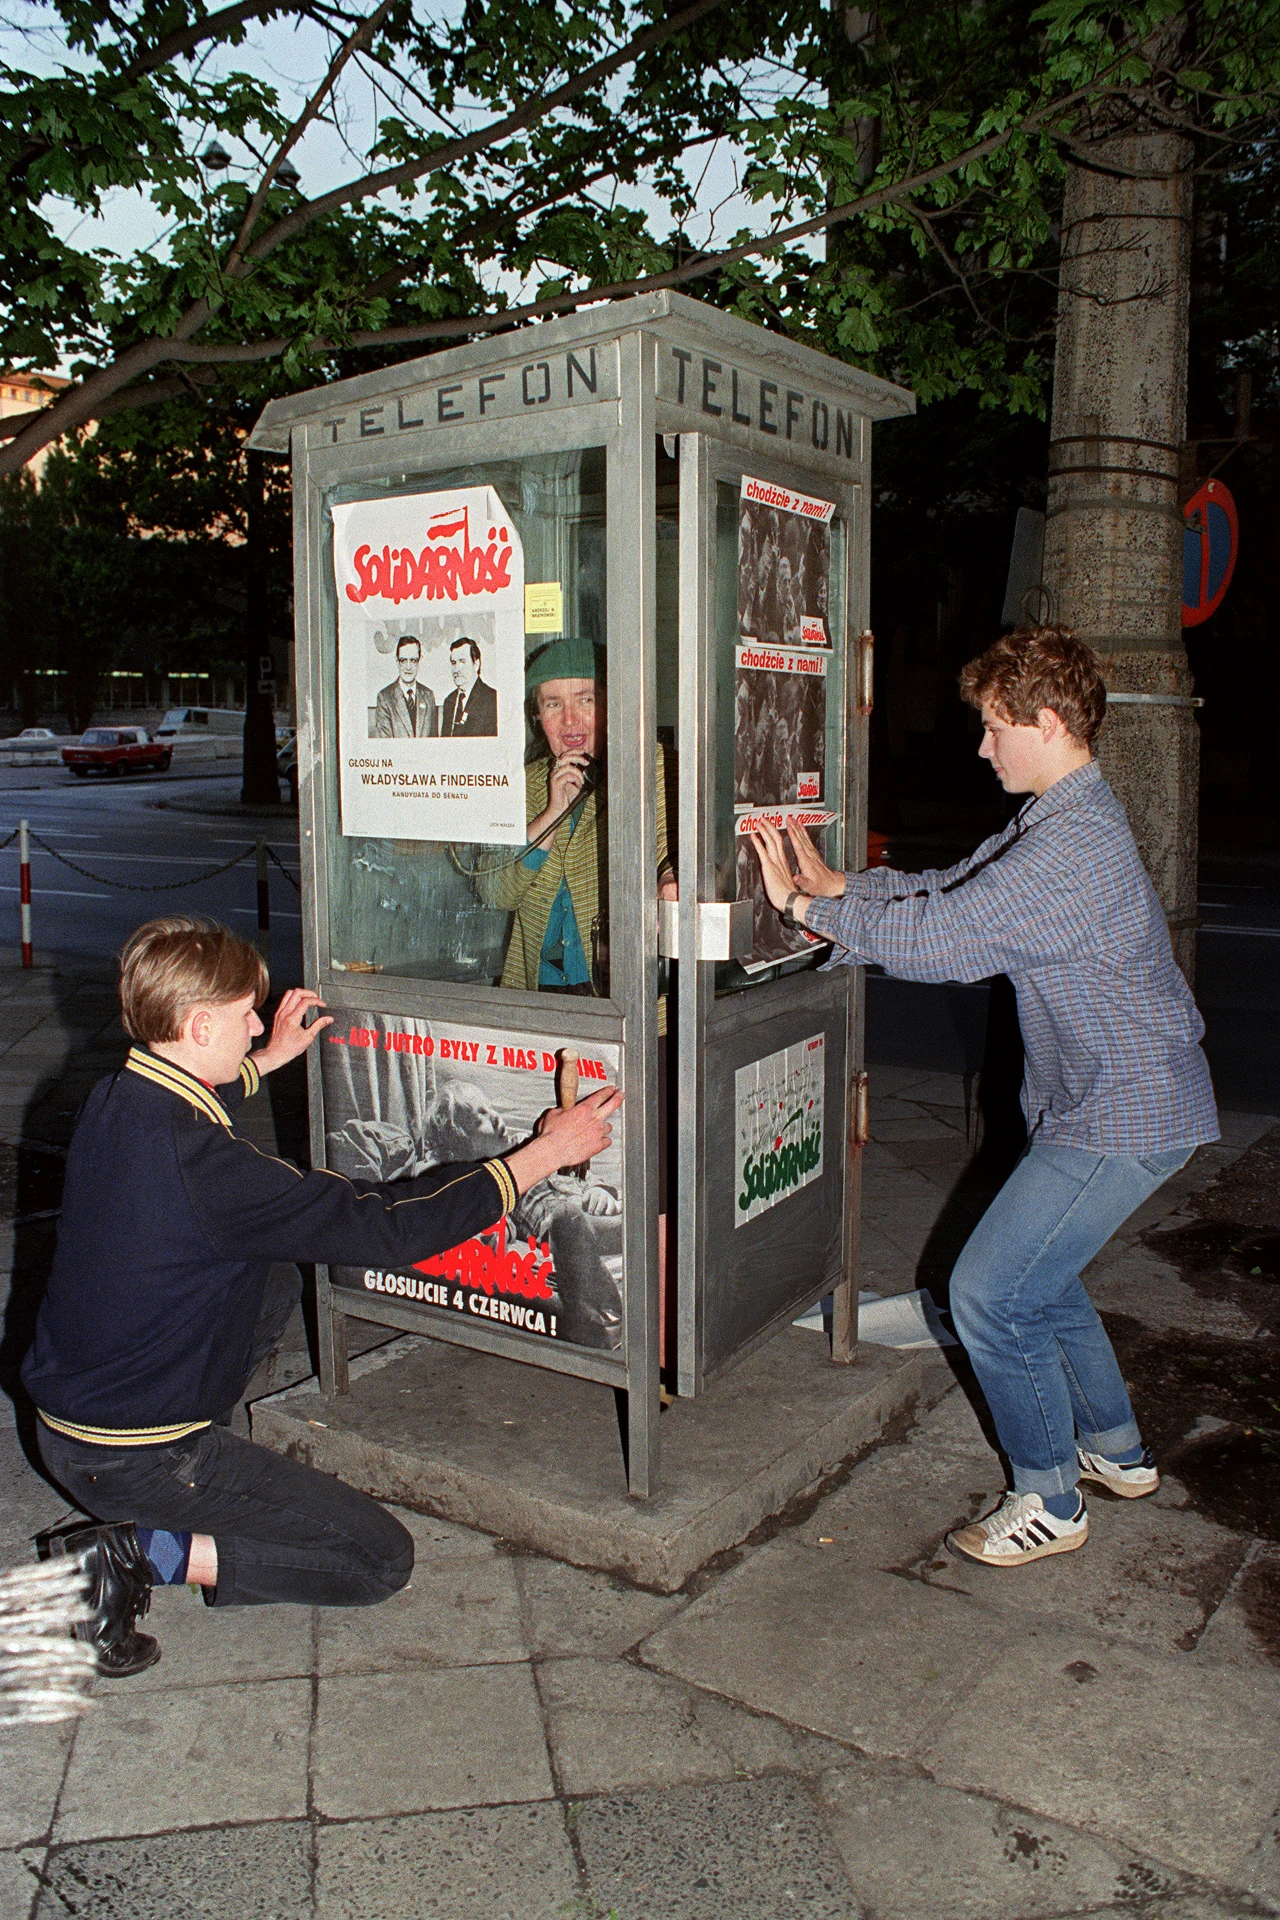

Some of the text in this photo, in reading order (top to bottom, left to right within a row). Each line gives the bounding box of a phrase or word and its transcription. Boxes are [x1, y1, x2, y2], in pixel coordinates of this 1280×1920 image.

[323, 346, 598, 444] TELEFON
[671, 346, 853, 460] TELEFON
[791, 498, 800, 511] z
[800, 500, 831, 519] nami!
[741, 648, 824, 673] chodźcie z nami!
[348, 758, 394, 768] GŁOSUJ NA
[361, 773, 509, 787] WŁADYSŁAWA FINDEISENA
[443, 792, 469, 800] SENATU
[349, 1026, 380, 1049] ABY
[383, 1031, 435, 1057] JUTRO
[440, 1038, 480, 1063] BYŁY
[486, 1044, 498, 1065] Z
[503, 1046, 538, 1071] NAS
[541, 1051, 607, 1081] DNE
[364, 1270, 448, 1306] GŁOSUJCIE
[453, 1289, 464, 1310] 4
[469, 1293, 547, 1334] CZERWCA
